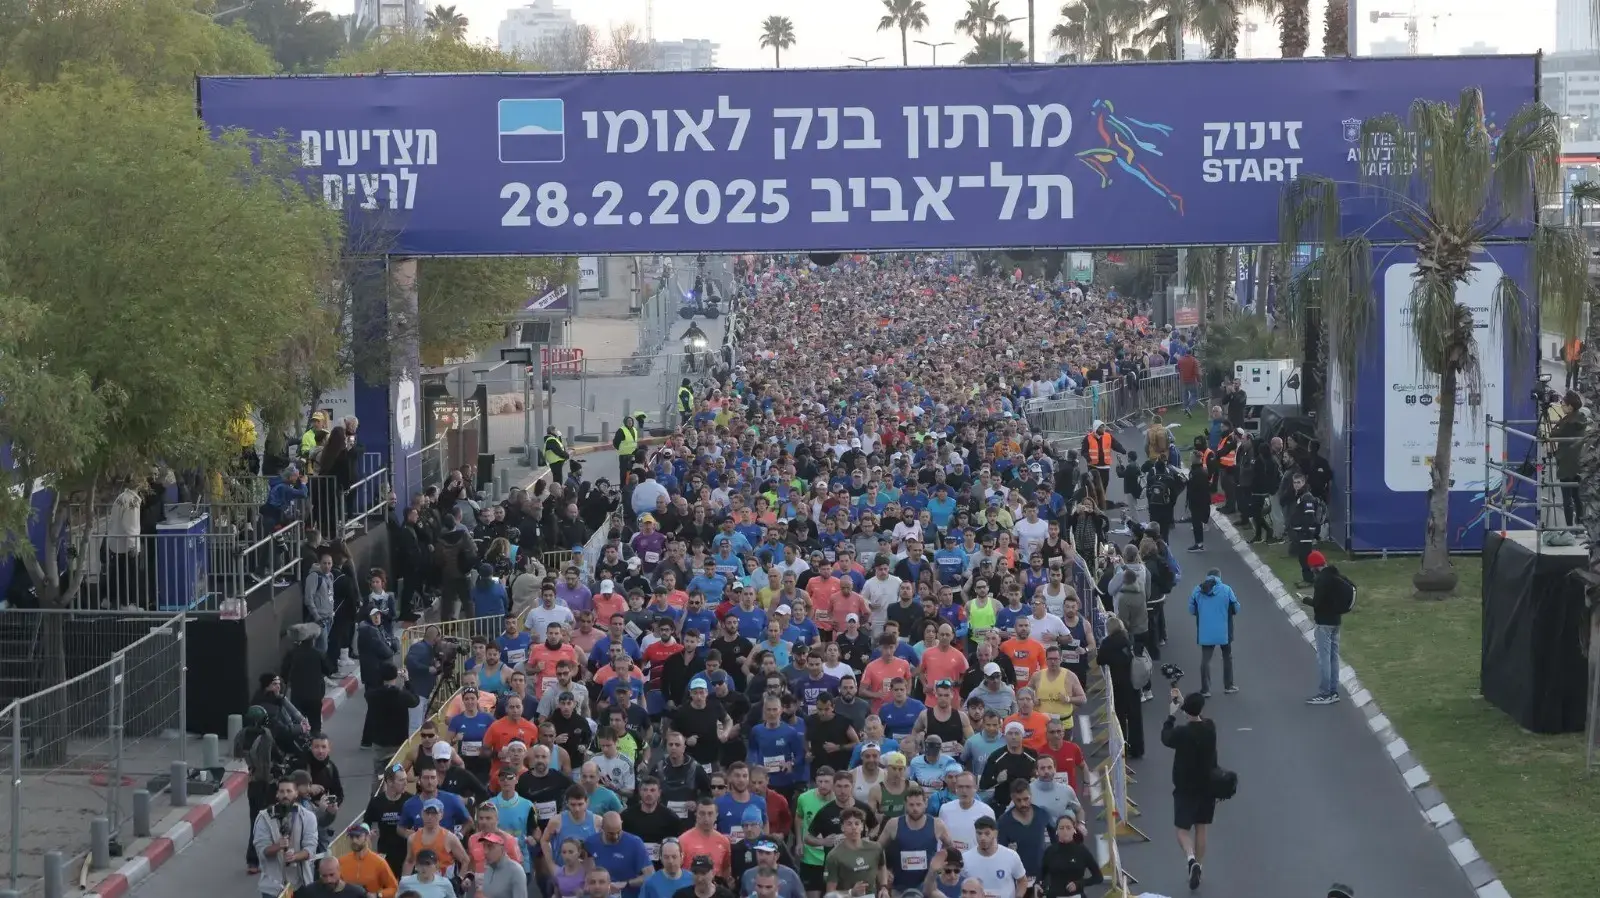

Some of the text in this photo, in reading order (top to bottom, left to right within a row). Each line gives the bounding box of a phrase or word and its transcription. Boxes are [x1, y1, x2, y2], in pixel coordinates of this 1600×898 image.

[301, 129, 437, 166] מצדיעים
[582, 96, 1072, 159] מרתון בנק לאומי
[1204, 121, 1303, 156] זינוק
[323, 167, 417, 210] לרצים
[1203, 157, 1303, 183] START
[500, 179, 790, 227] 28.2.2025
